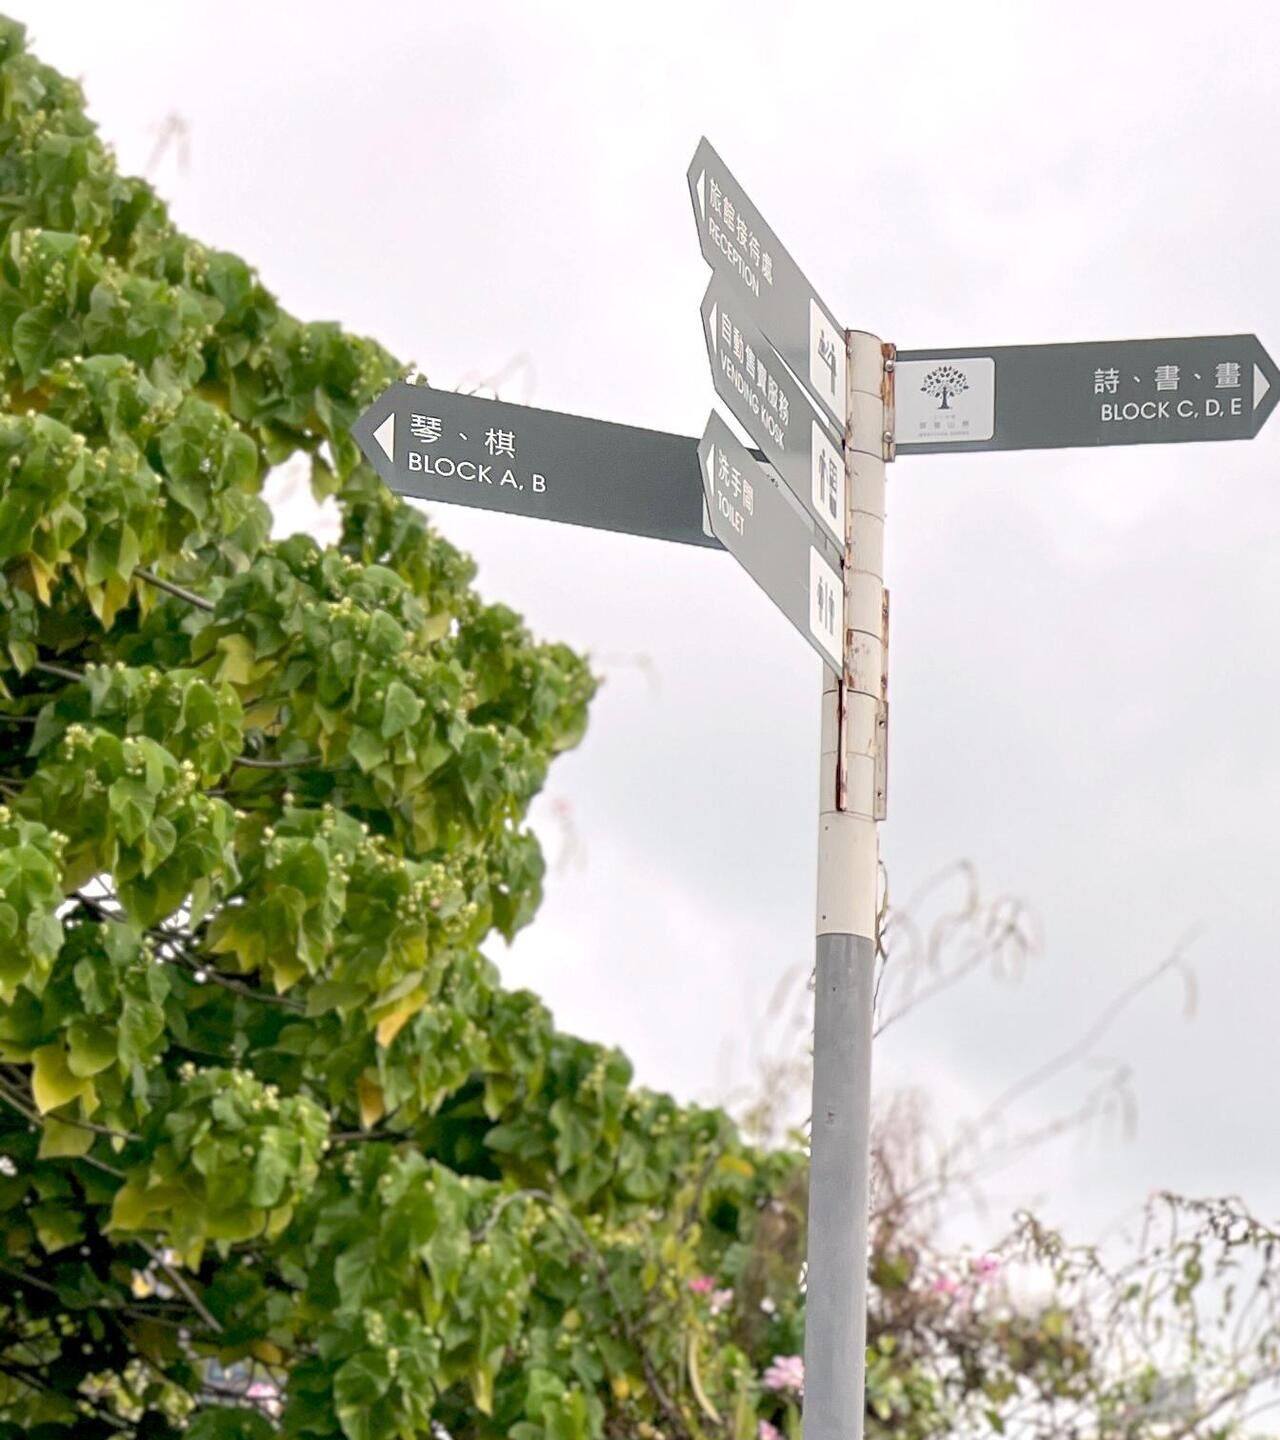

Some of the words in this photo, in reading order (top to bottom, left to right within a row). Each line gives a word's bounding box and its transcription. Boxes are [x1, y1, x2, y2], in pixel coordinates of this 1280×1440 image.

[708, 216, 760, 297] RECEPTION
[720, 348, 760, 415] VENDING
[760, 402, 785, 451] KIOSK
[1101, 401, 1170, 421] BLOCK
[1177, 400, 1199, 419] C,
[1205, 399, 1225, 417] D,
[1231, 397, 1242, 415] E
[408, 452, 493, 485] BLOCK
[500, 469, 524, 491] A,
[532, 474, 547, 493] B
[718, 451, 754, 517] 洗手間
[717, 490, 745, 536] TOILET
